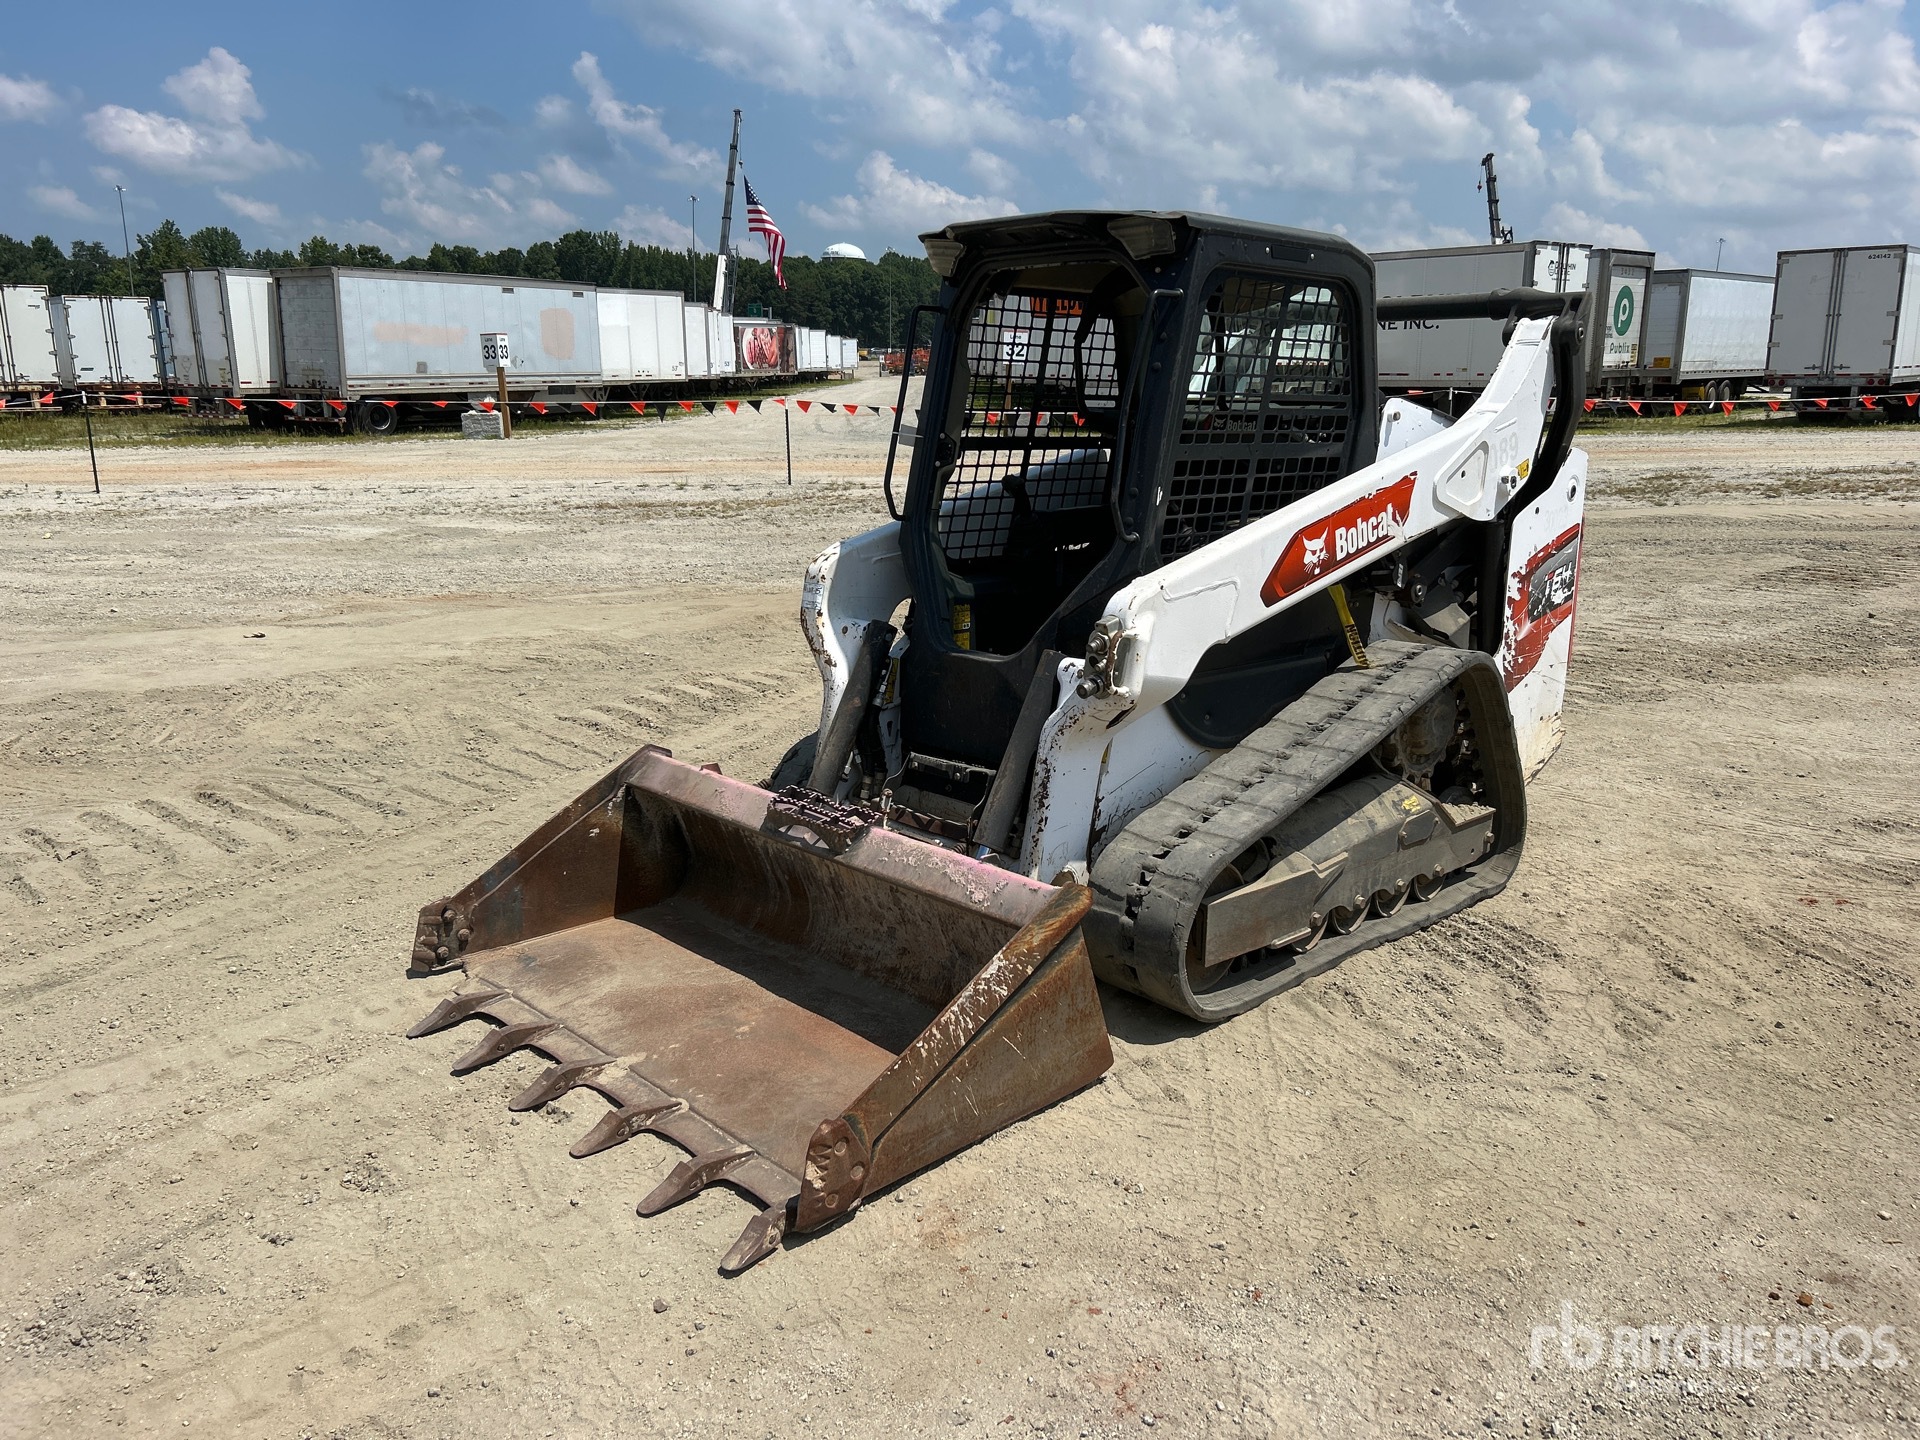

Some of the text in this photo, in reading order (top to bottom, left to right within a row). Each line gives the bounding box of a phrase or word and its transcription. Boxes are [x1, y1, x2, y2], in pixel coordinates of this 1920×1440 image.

[483, 344, 497, 360] 33
[499, 344, 509, 360] 33
[1005, 344, 1025, 358] 32
[1609, 342, 1630, 354] Publix
[1335, 502, 1394, 561] Bobcat
